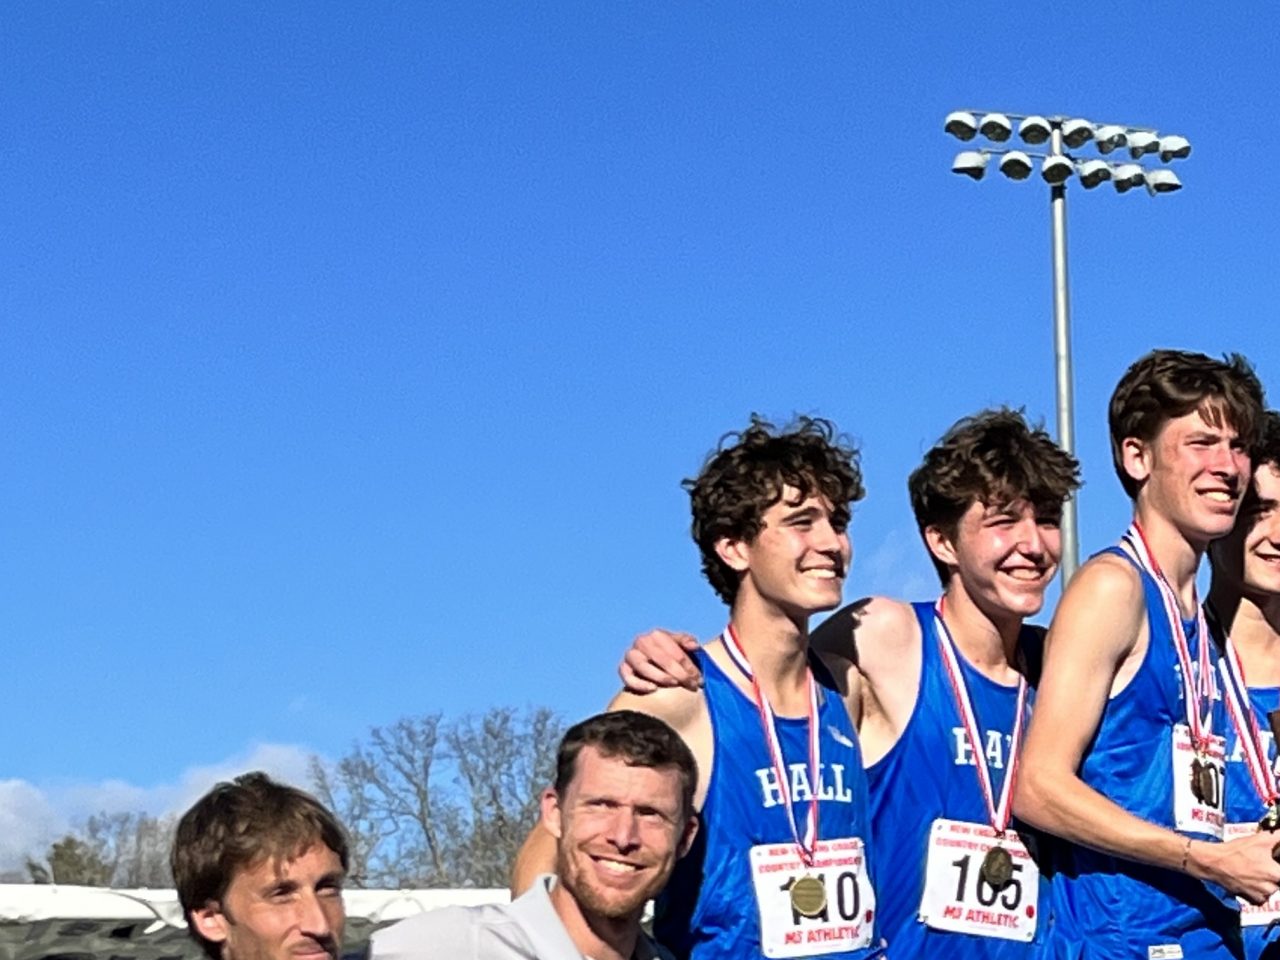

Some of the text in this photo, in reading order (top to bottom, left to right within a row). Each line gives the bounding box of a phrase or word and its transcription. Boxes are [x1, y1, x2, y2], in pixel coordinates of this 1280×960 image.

[952, 727, 1013, 769] HA
[965, 908, 1019, 929] ATHLETIC
[807, 924, 861, 943] ATHLETIC
